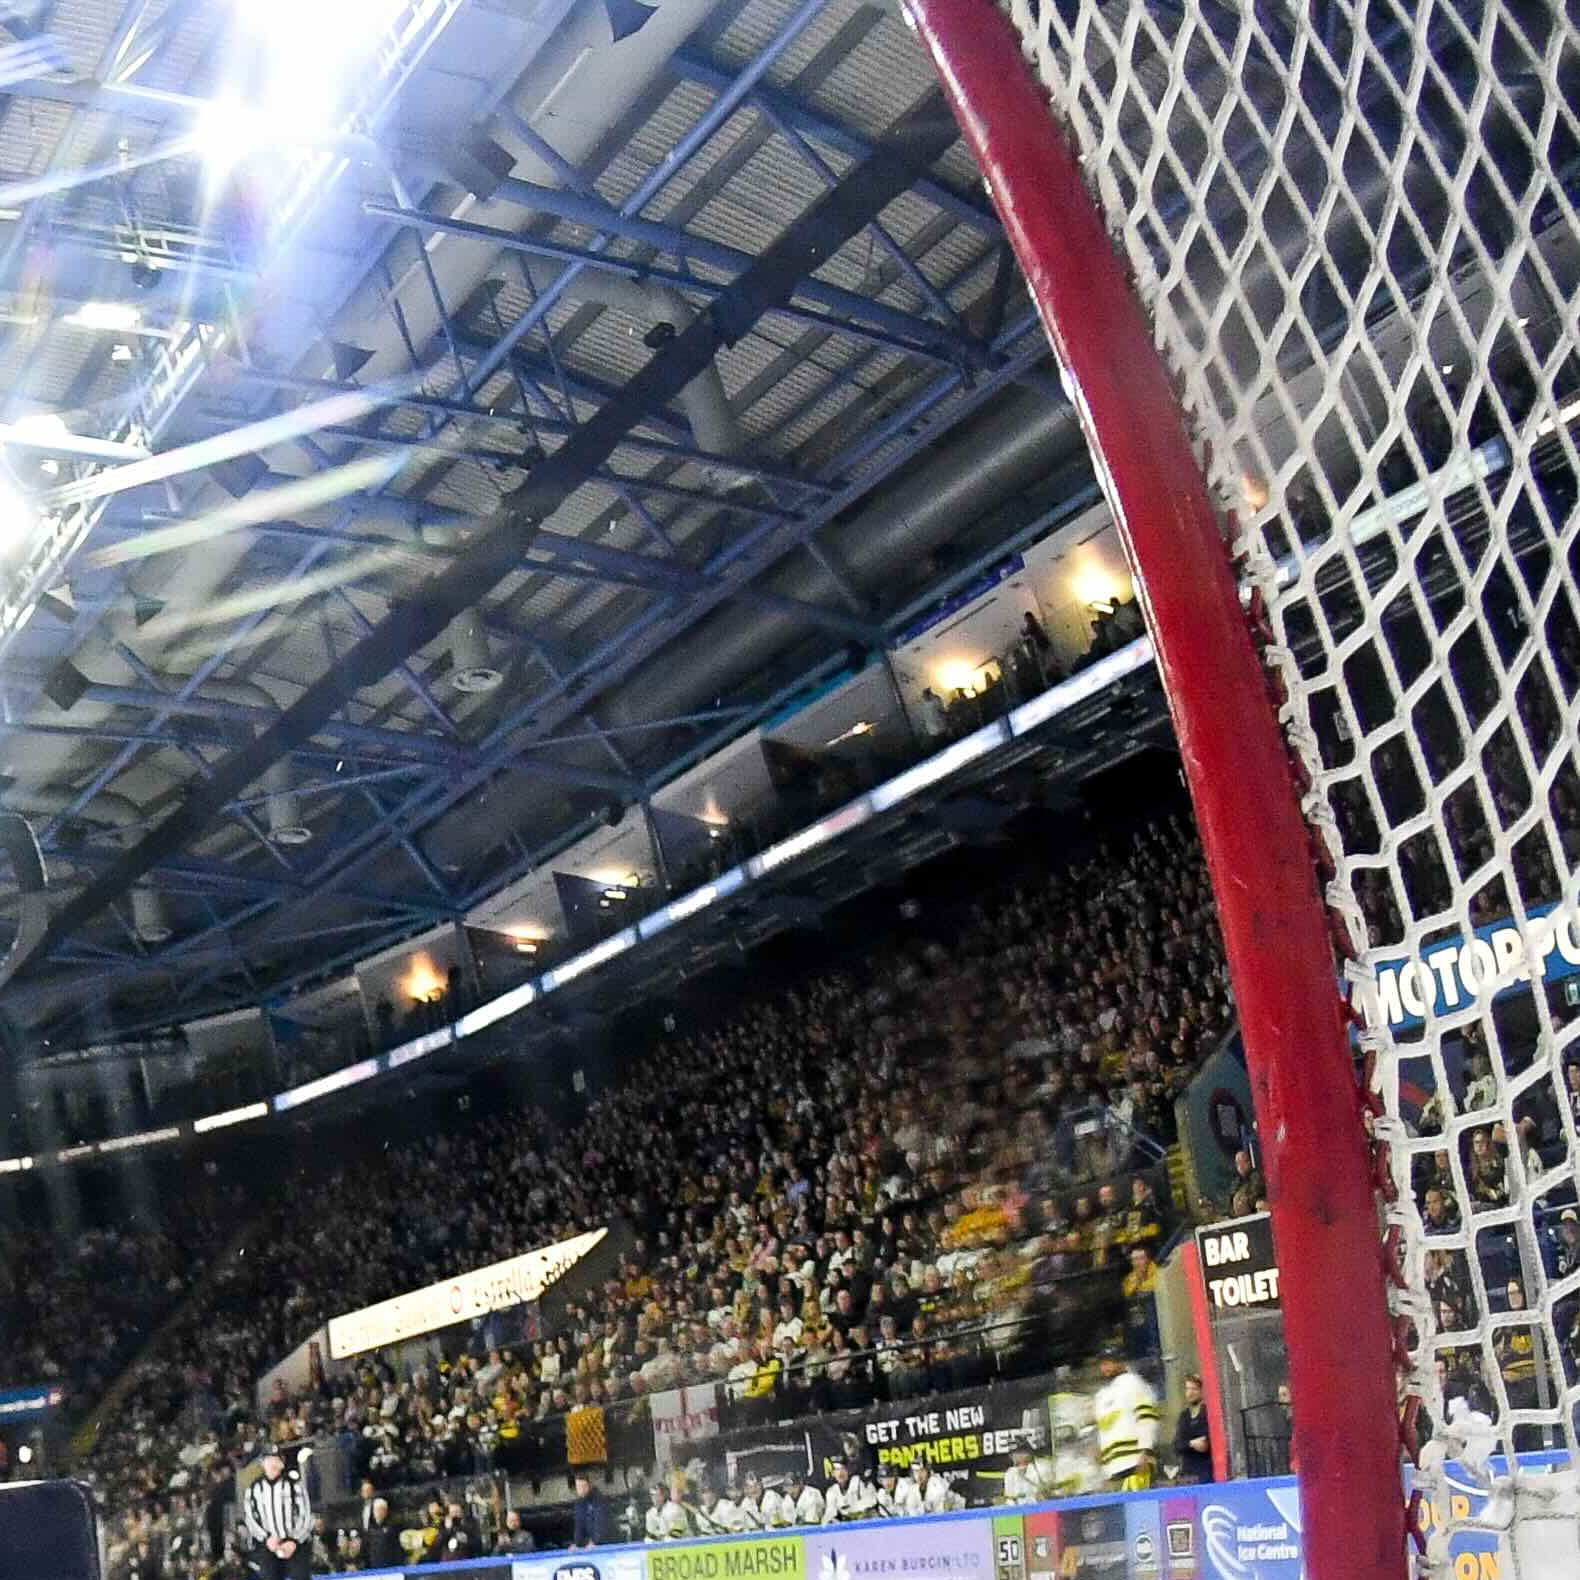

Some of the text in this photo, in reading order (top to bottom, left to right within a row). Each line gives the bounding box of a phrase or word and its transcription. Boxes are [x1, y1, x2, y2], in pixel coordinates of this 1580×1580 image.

[1204, 1231, 1250, 1267] BAR
[1209, 1268, 1279, 1308] TOILET
[866, 1406, 985, 1444] GET THE NEW
[878, 1435, 979, 1468] PANTHERS
[725, 1546, 798, 1576] MARSH
